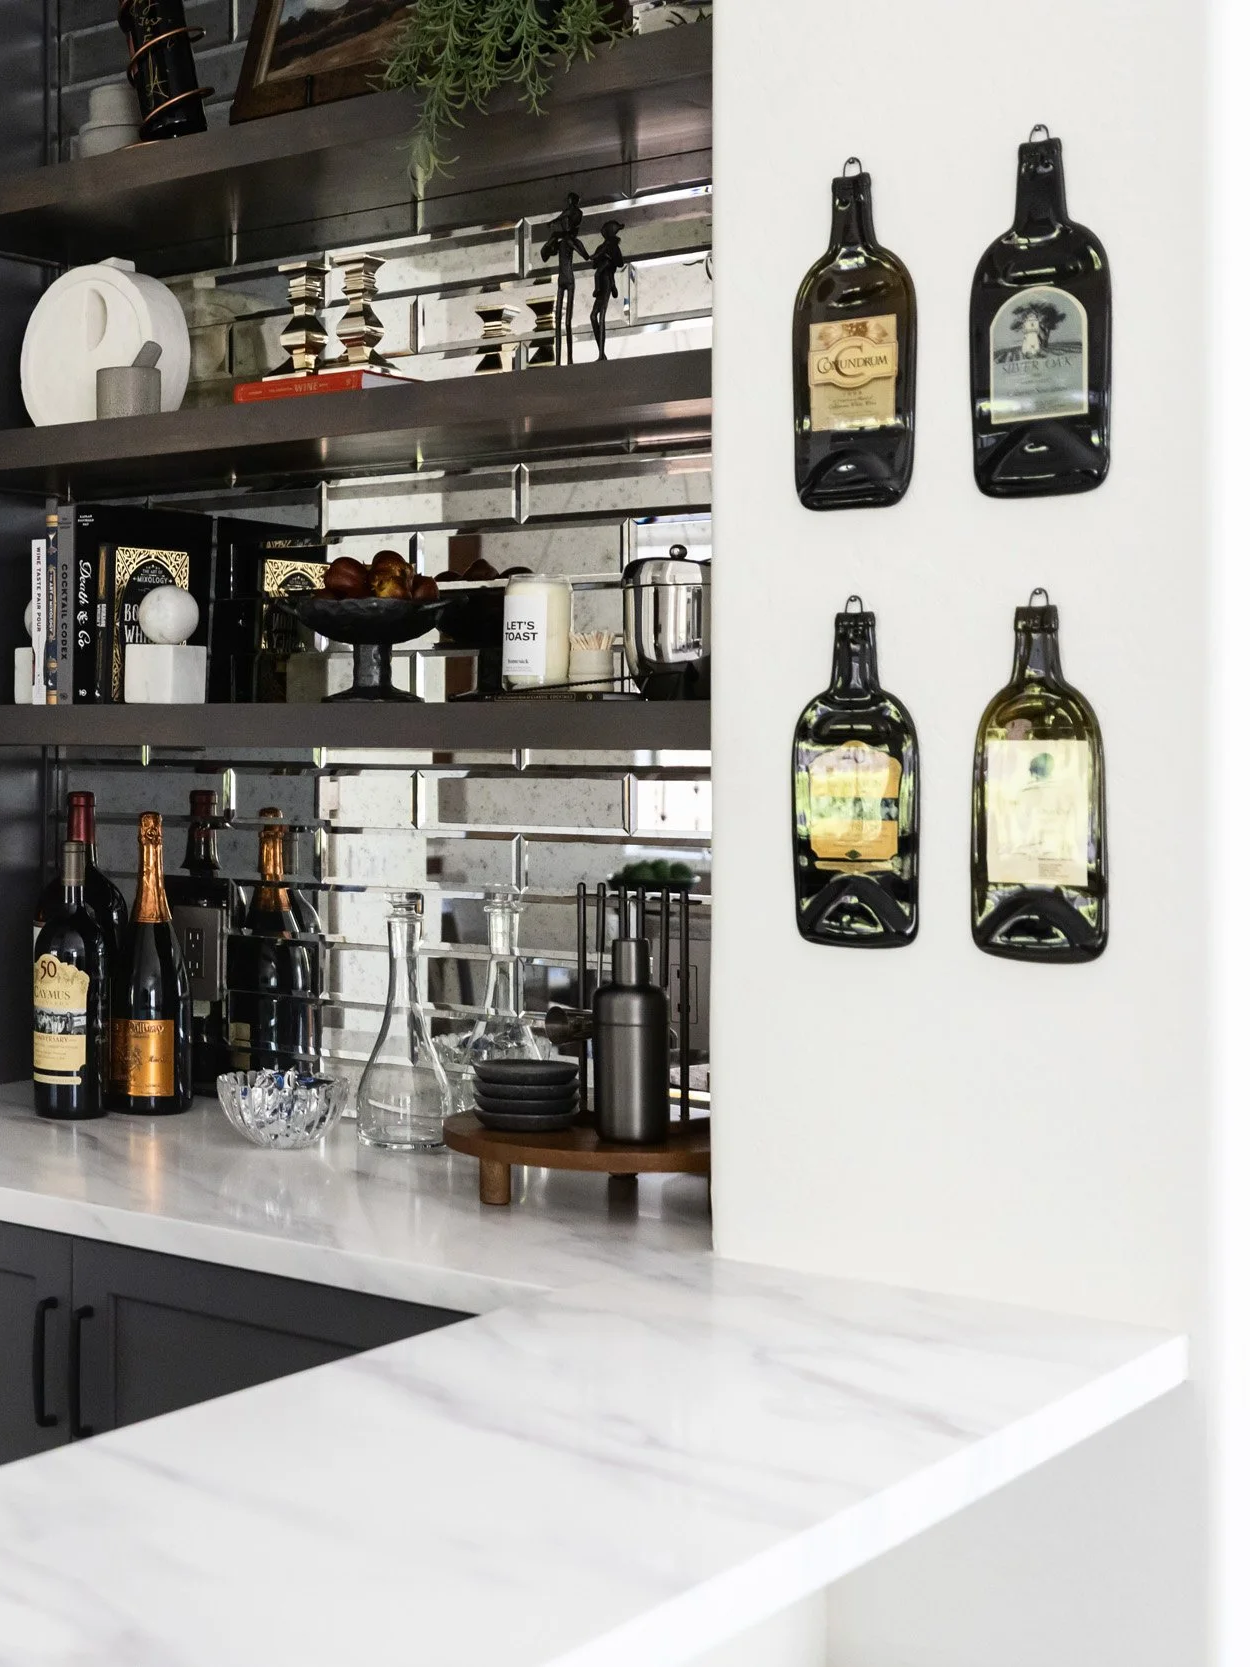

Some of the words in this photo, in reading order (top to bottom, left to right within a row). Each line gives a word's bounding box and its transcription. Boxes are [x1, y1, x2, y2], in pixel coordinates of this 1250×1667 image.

[816, 355, 888, 375] CONUNDRUM
[293, 381, 319, 393] WINE
[78, 559, 92, 605] Death
[76, 610, 89, 626] &
[506, 620, 535, 631] LET'S
[78, 630, 91, 649] Co
[505, 632, 538, 641] TOAST
[40, 960, 57, 979] 50
[34, 985, 71, 1000] CAYMUS
